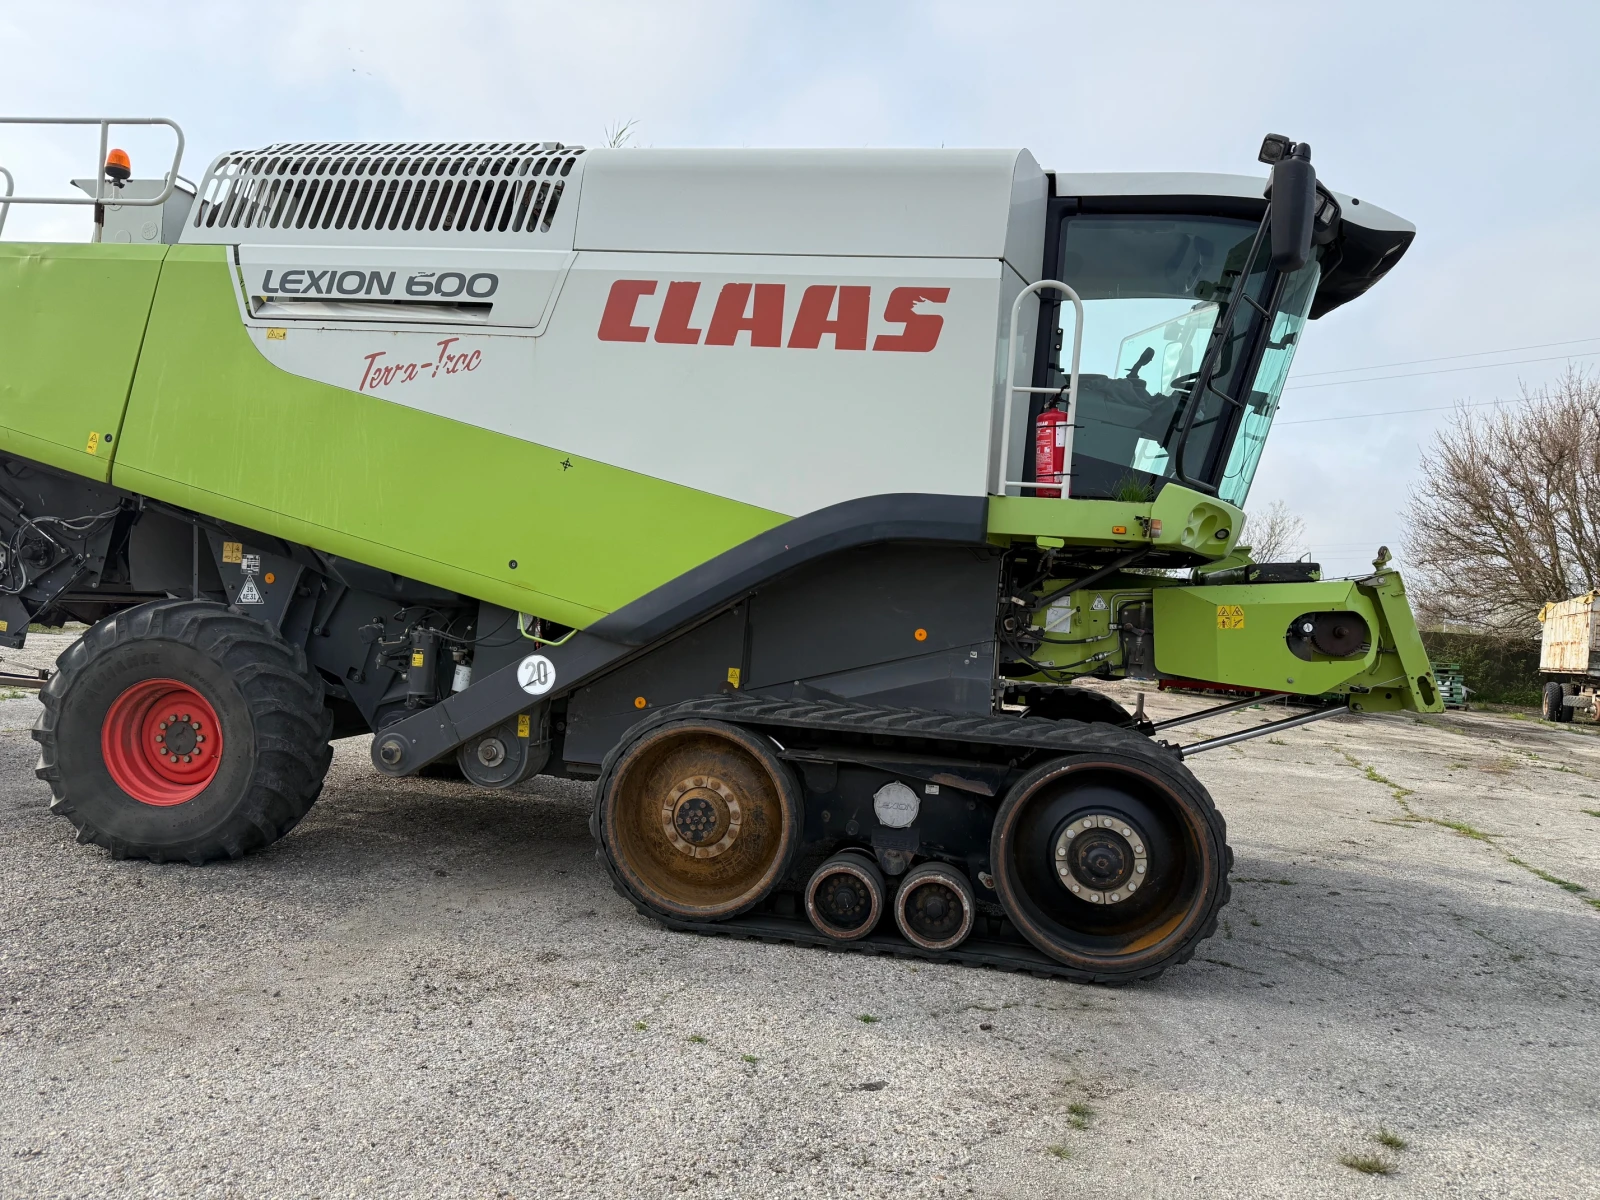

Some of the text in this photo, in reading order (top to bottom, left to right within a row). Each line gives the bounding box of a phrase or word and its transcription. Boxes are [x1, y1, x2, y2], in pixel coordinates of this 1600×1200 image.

[261, 269, 499, 298] LEXION 600
[597, 279, 951, 352] CLAAS
[359, 337, 482, 391] Terra-Trac
[525, 660, 548, 687] 20
